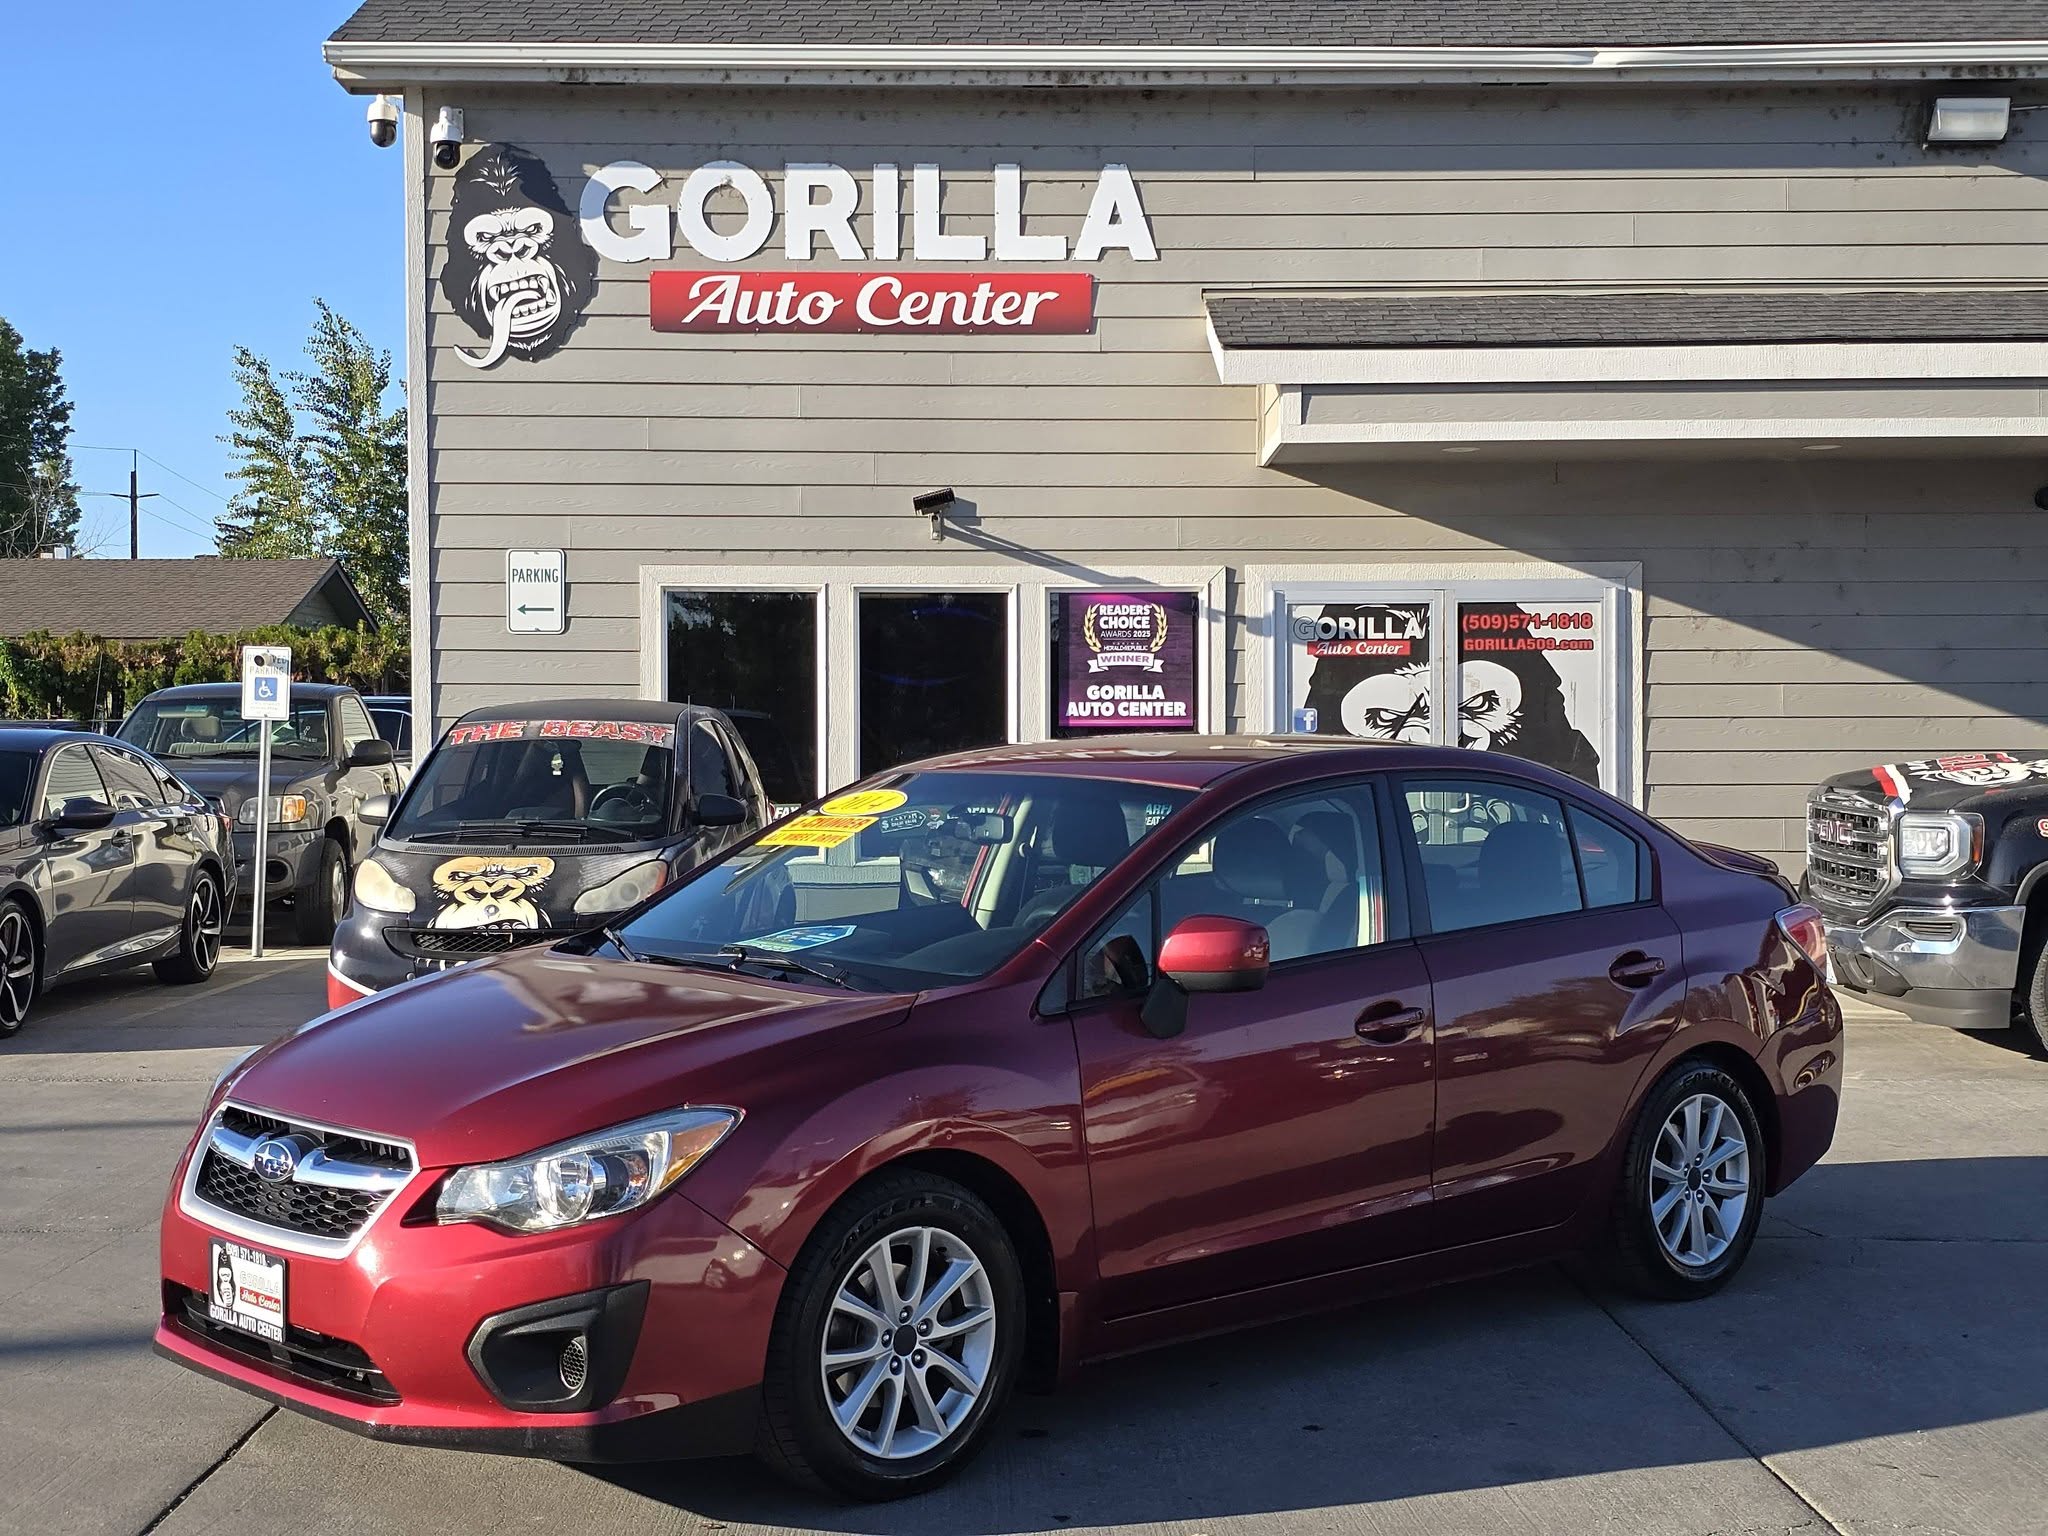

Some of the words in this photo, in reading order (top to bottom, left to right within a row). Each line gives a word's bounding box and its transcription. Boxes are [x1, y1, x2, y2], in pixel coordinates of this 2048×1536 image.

[580, 160, 1159, 263] GORILLA
[681, 274, 844, 326] Auto
[857, 275, 1060, 327] Center
[512, 568, 559, 583] PARKING
[1099, 616, 1151, 629] CHOICE
[1293, 616, 1424, 641] GORILLA
[1462, 613, 1593, 633] (509)571-1818
[1101, 630, 1132, 638] AWARDS
[1132, 630, 1151, 638] 2025
[1315, 641, 1353, 655] Auto
[1355, 641, 1403, 655] Center
[1463, 637, 1594, 651] GORILLA509.com
[1100, 655, 1150, 663] WINNER
[249, 665, 285, 676] PARKING
[1086, 684, 1165, 700] GORILLA
[1066, 701, 1115, 717] AUTO
[1117, 701, 1187, 717] CENTER
[449, 721, 527, 745] THE
[540, 720, 674, 746] BEAST
[1818, 820, 1851, 846] GMC
[209, 1304, 238, 1327] GORILLA
[238, 1314, 257, 1333] AUTO
[257, 1319, 283, 1343] CENTER
